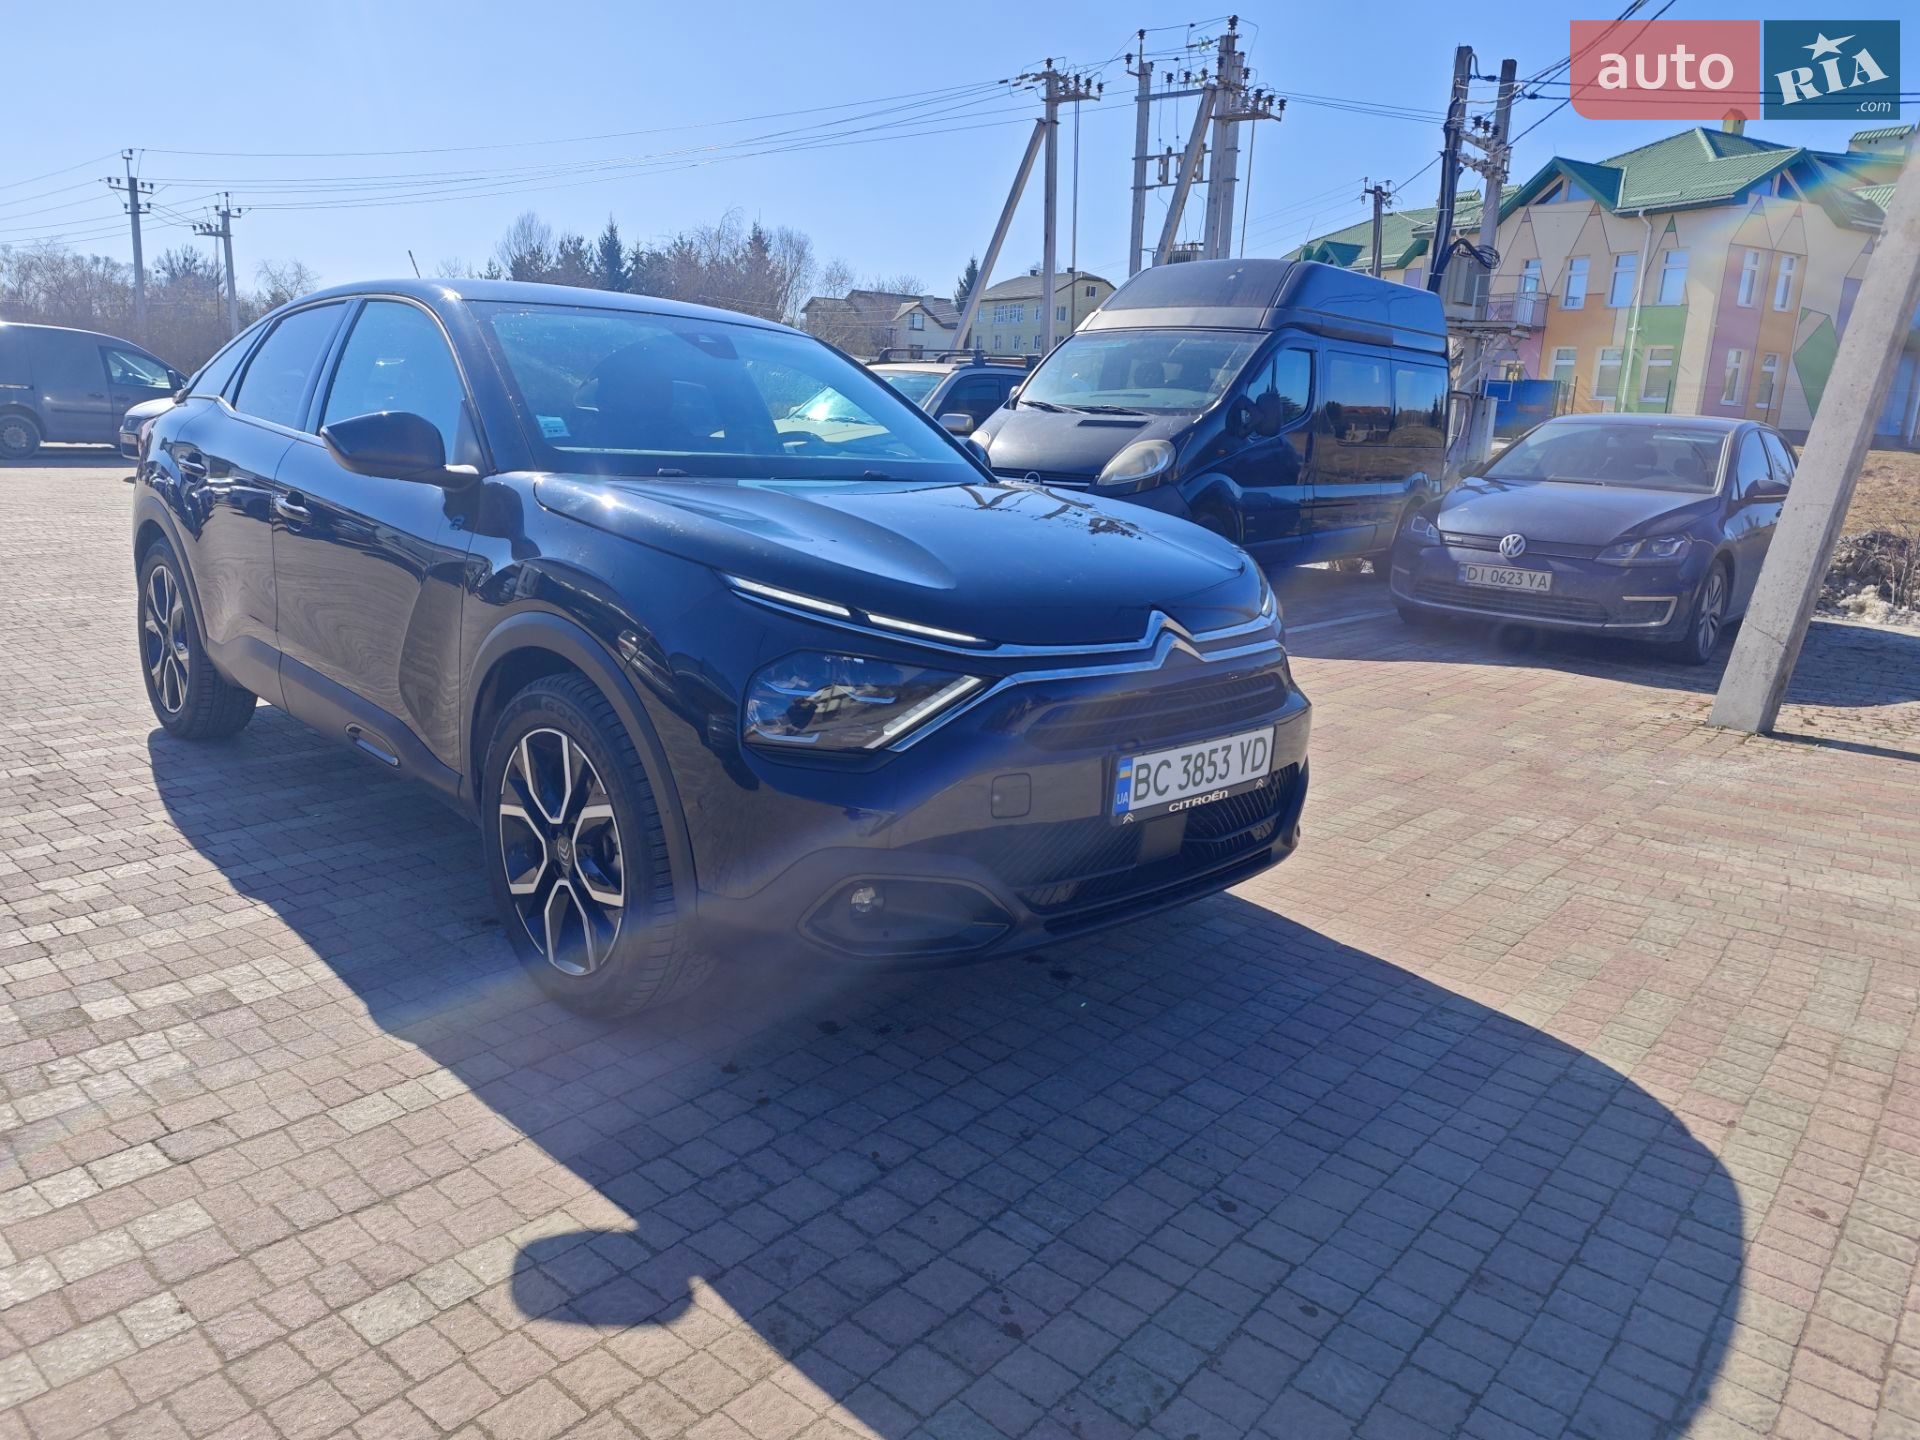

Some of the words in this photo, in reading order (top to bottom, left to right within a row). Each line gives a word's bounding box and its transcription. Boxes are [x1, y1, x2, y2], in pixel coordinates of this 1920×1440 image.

[1467, 566, 1485, 581] DI
[1490, 569, 1524, 586] 0623
[1528, 573, 1548, 589] YA
[1133, 759, 1172, 802] BC
[1178, 744, 1232, 791] 3853
[1240, 736, 1268, 776] YD
[1116, 791, 1129, 805] UA
